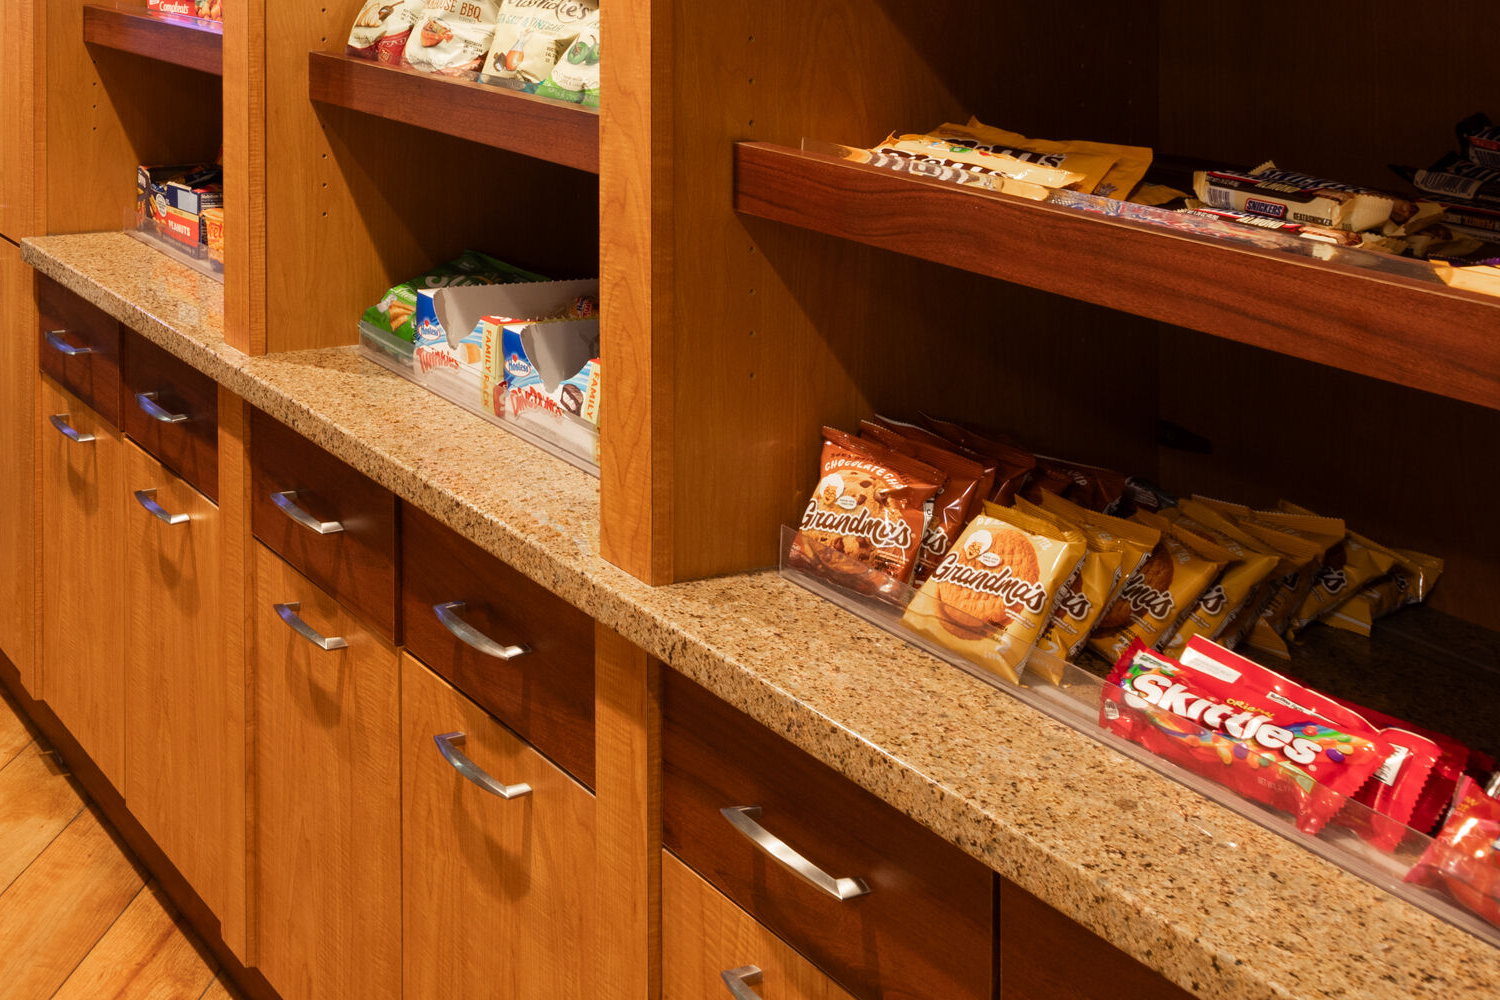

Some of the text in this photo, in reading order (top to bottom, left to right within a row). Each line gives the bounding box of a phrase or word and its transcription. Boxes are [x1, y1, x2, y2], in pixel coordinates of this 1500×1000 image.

[459, 2, 482, 23] BBQ
[1246, 199, 1283, 217] SNICKERS
[168, 219, 191, 237] PEANUTS
[1236, 216, 1286, 230] ALMOND
[419, 324, 440, 339] Hostess
[483, 329, 493, 373] FAMILY
[506, 361, 531, 374] Hostess
[587, 371, 600, 420] FAMILY
[824, 458, 886, 477] CHOCOLATE
[799, 498, 912, 549] Grandma's
[930, 552, 1048, 614] Grandma's
[1124, 673, 1322, 765] Skittles
